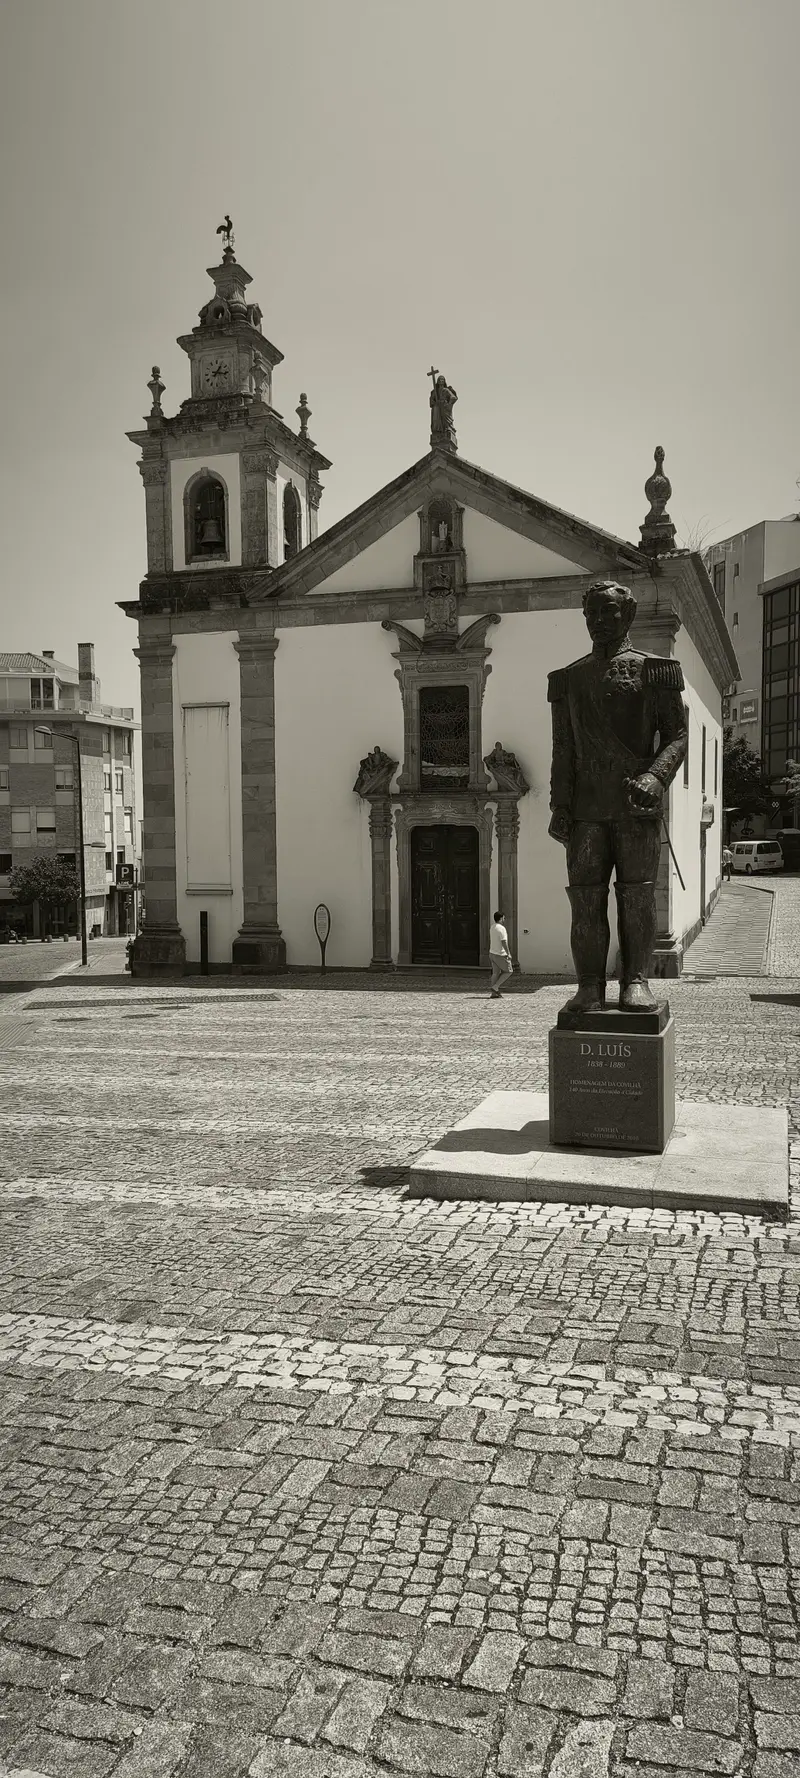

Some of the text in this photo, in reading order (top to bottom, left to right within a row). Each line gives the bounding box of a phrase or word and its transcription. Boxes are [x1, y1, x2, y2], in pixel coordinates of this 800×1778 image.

[121, 866, 130, 879] P
[580, 1042, 632, 1058] D. LUÍS
[587, 1060, 604, 1068] 1838
[609, 1061, 626, 1069] 1889
[570, 1079, 607, 1087] HOMENAGEM
